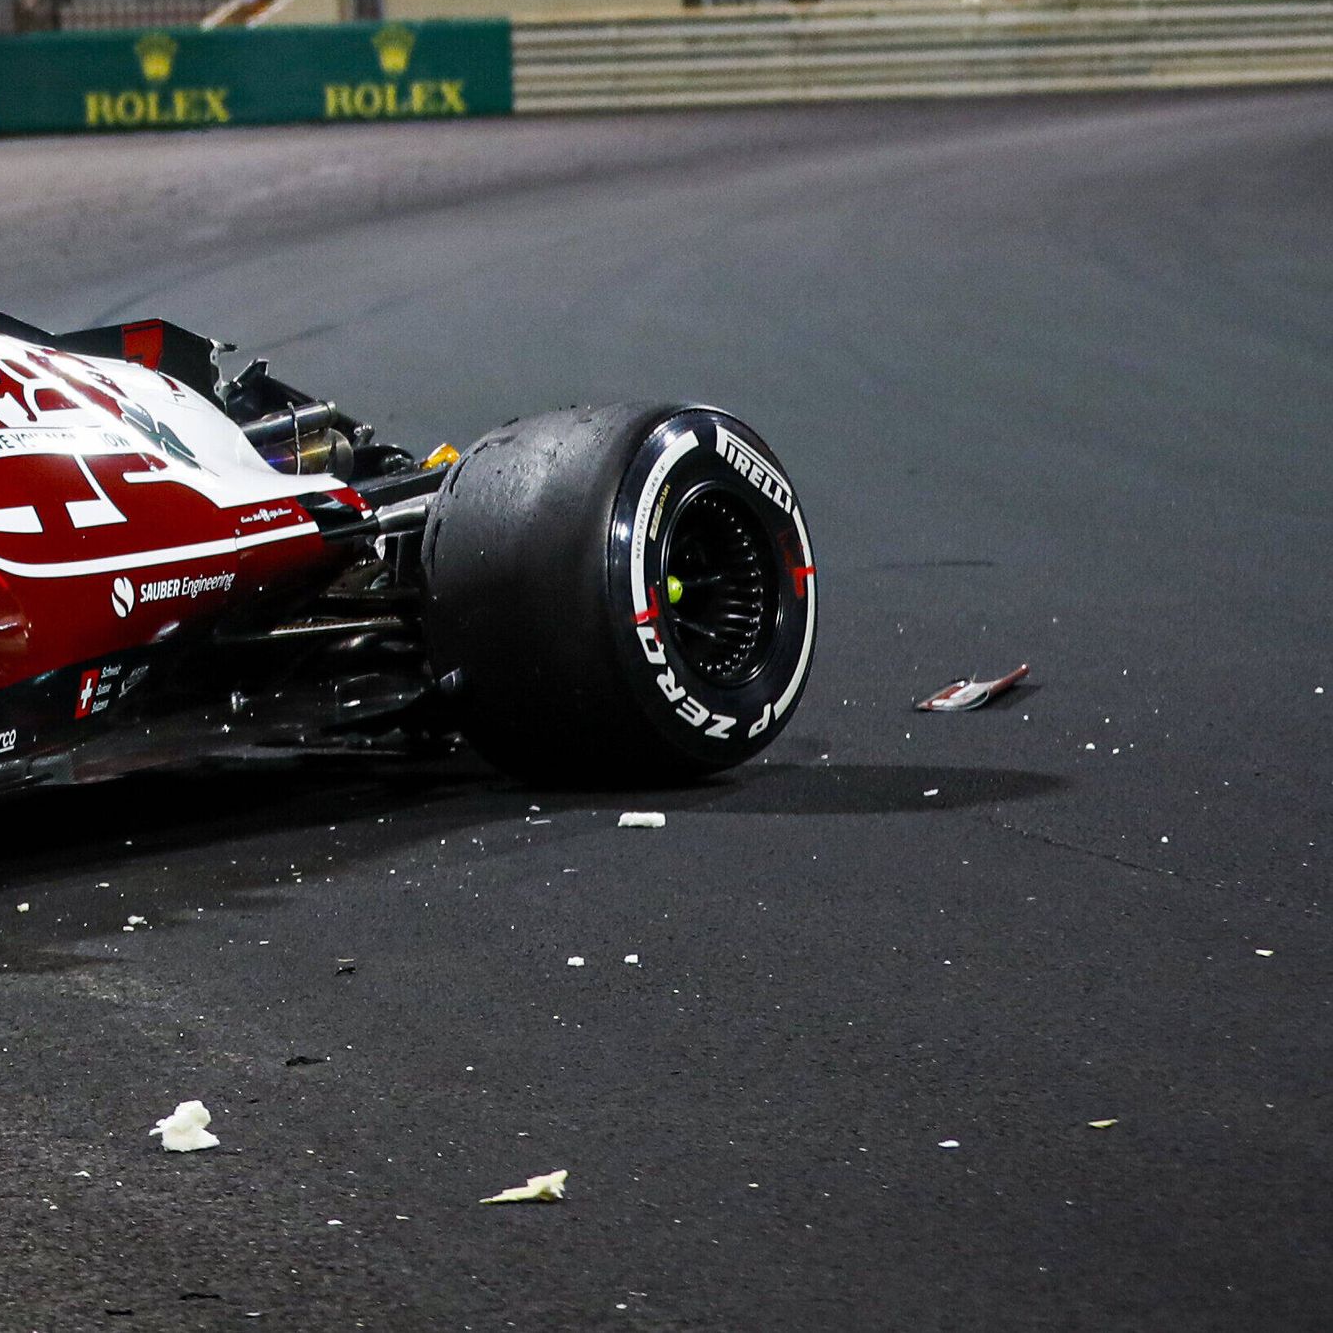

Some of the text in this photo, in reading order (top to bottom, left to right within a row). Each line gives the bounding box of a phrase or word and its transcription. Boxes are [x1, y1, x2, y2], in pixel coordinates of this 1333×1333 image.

[85, 87, 229, 126] ROLEX
[325, 79, 467, 119] ROLEX
[715, 424, 793, 514] PIRELLI
[140, 571, 235, 603] SAUBER Engineering
[636, 626, 772, 740] P ZERO
